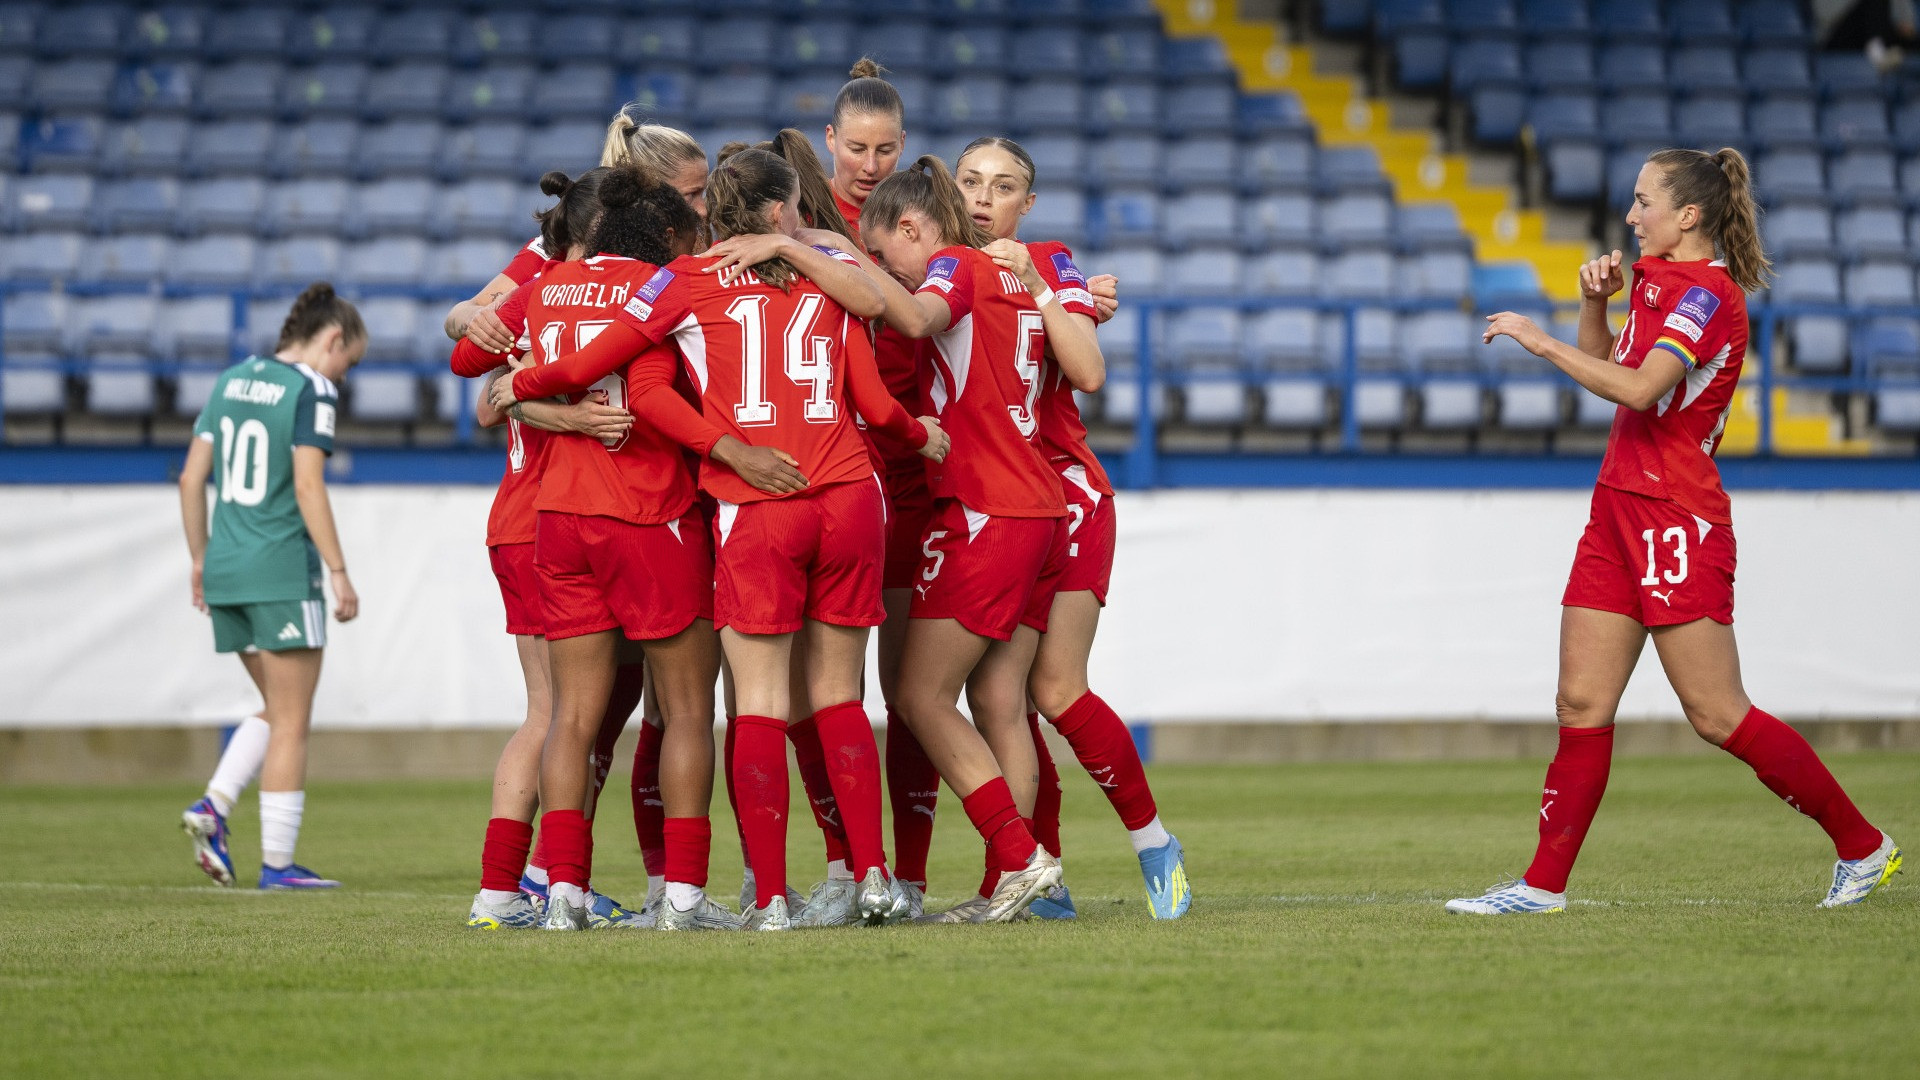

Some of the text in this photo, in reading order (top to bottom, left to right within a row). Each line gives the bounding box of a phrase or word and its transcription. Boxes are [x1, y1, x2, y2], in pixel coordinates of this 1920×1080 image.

[223, 378, 286, 406] HALLIDAY
[725, 293, 838, 427] 14
[1007, 310, 1044, 441] 5
[220, 416, 269, 507] 10
[922, 530, 948, 581] 5
[1641, 526, 1688, 586] 13
